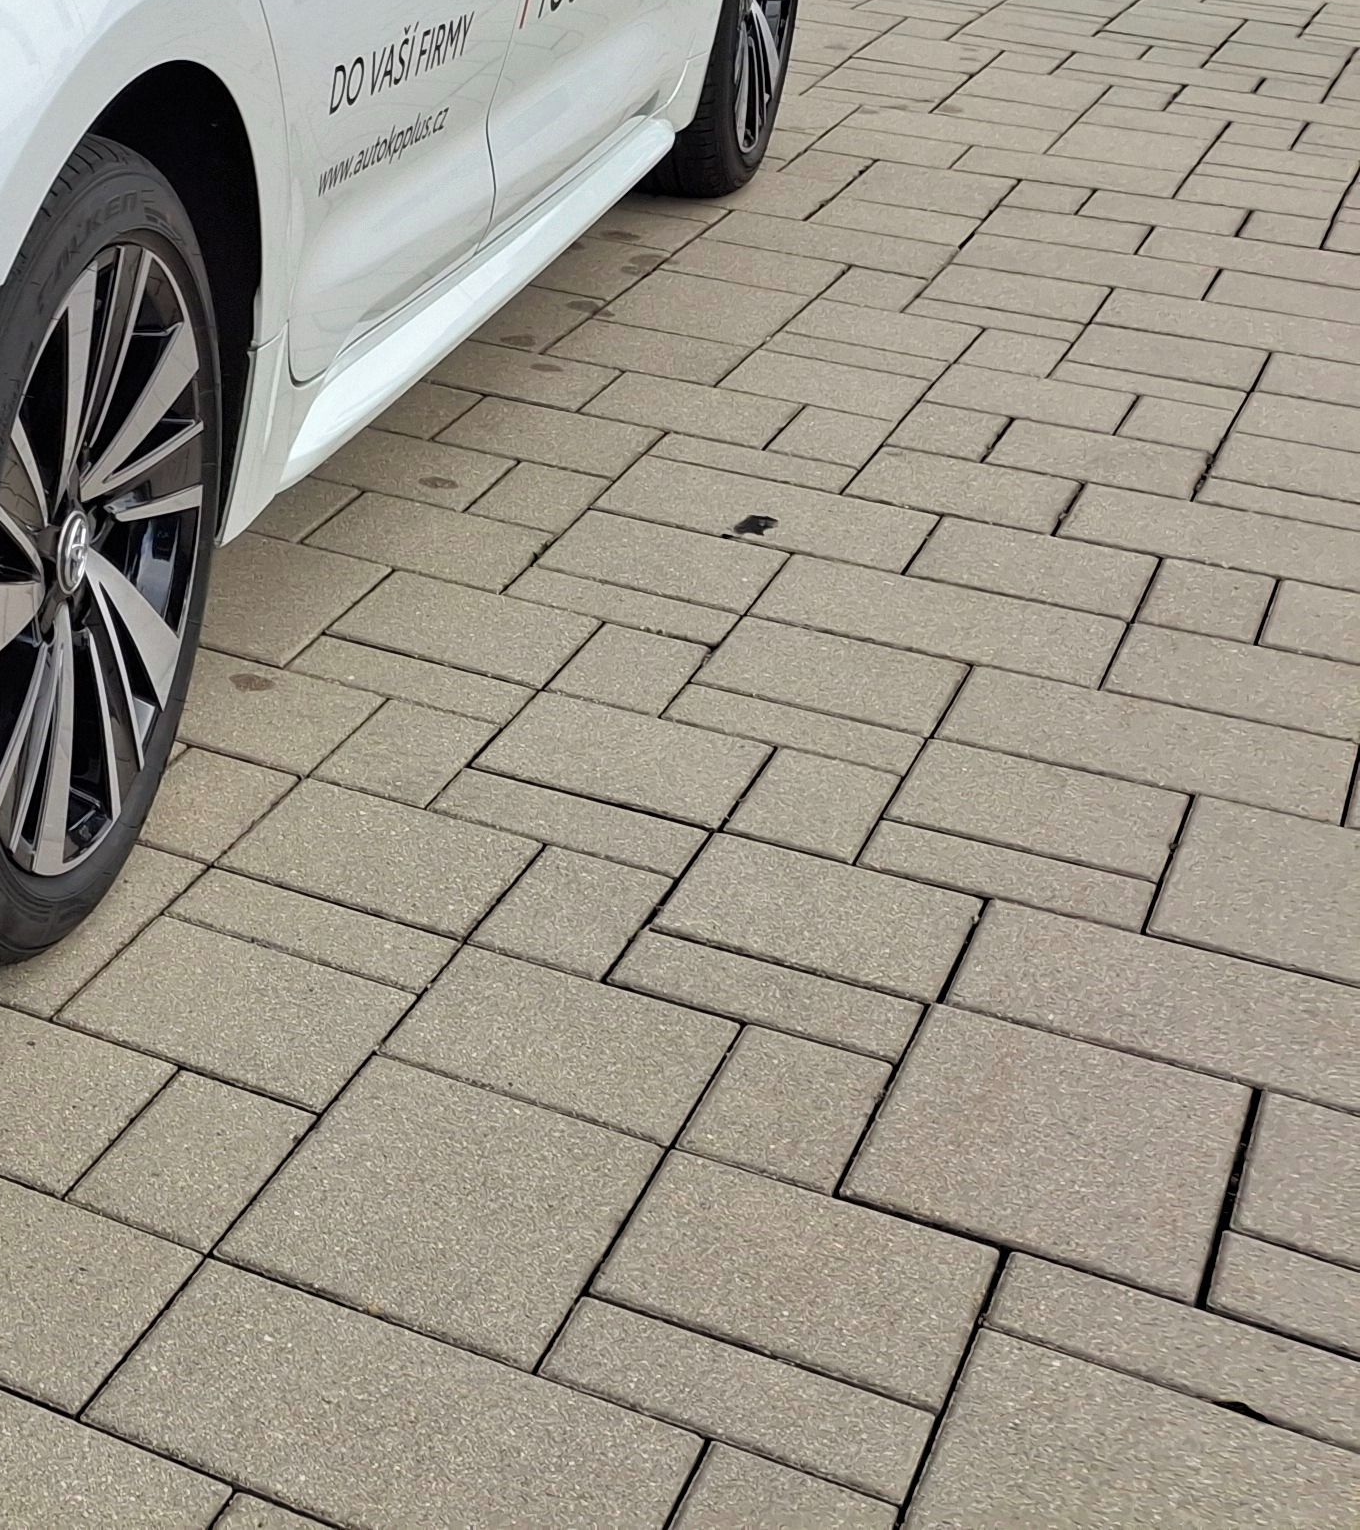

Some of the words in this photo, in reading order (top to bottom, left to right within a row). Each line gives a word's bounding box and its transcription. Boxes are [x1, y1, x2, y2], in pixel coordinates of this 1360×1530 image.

[329, 56, 365, 116] DO
[370, 21, 420, 96] VAŠÍ
[415, 11, 475, 78] FIRMY
[318, 107, 450, 197] www.autokpplus.cz
